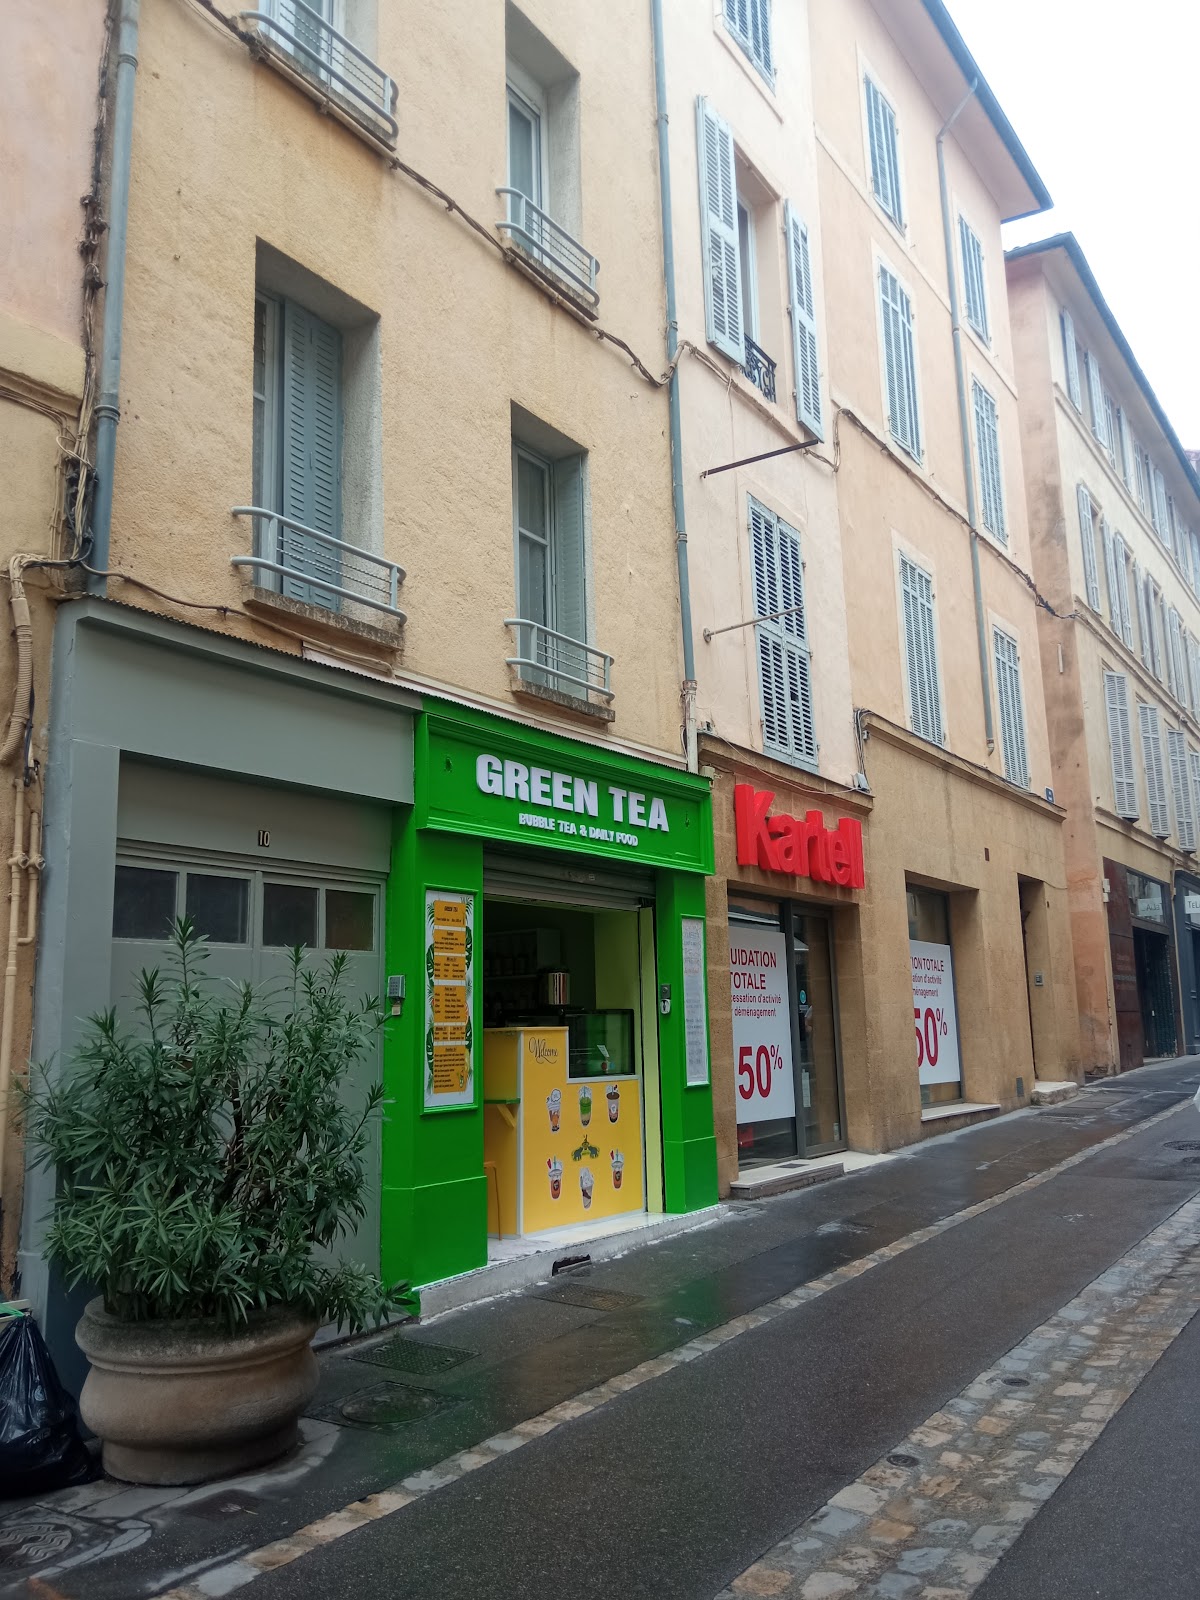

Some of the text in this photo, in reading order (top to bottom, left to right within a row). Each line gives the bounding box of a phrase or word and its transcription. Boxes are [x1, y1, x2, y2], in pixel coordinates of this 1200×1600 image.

[475, 754, 669, 833] GREEN TEA
[259, 830, 270, 846] 10
[518, 812, 639, 847] BUBBLE TEA & DAILY FOOD
[735, 784, 865, 889] Kartell
[730, 947, 777, 968] UIDATION
[911, 956, 945, 972] ION TOTALE
[731, 992, 757, 1003] essation
[528, 1036, 559, 1064] Welcome
[913, 1007, 948, 1067] 50%
[738, 1044, 783, 1100] 50%
